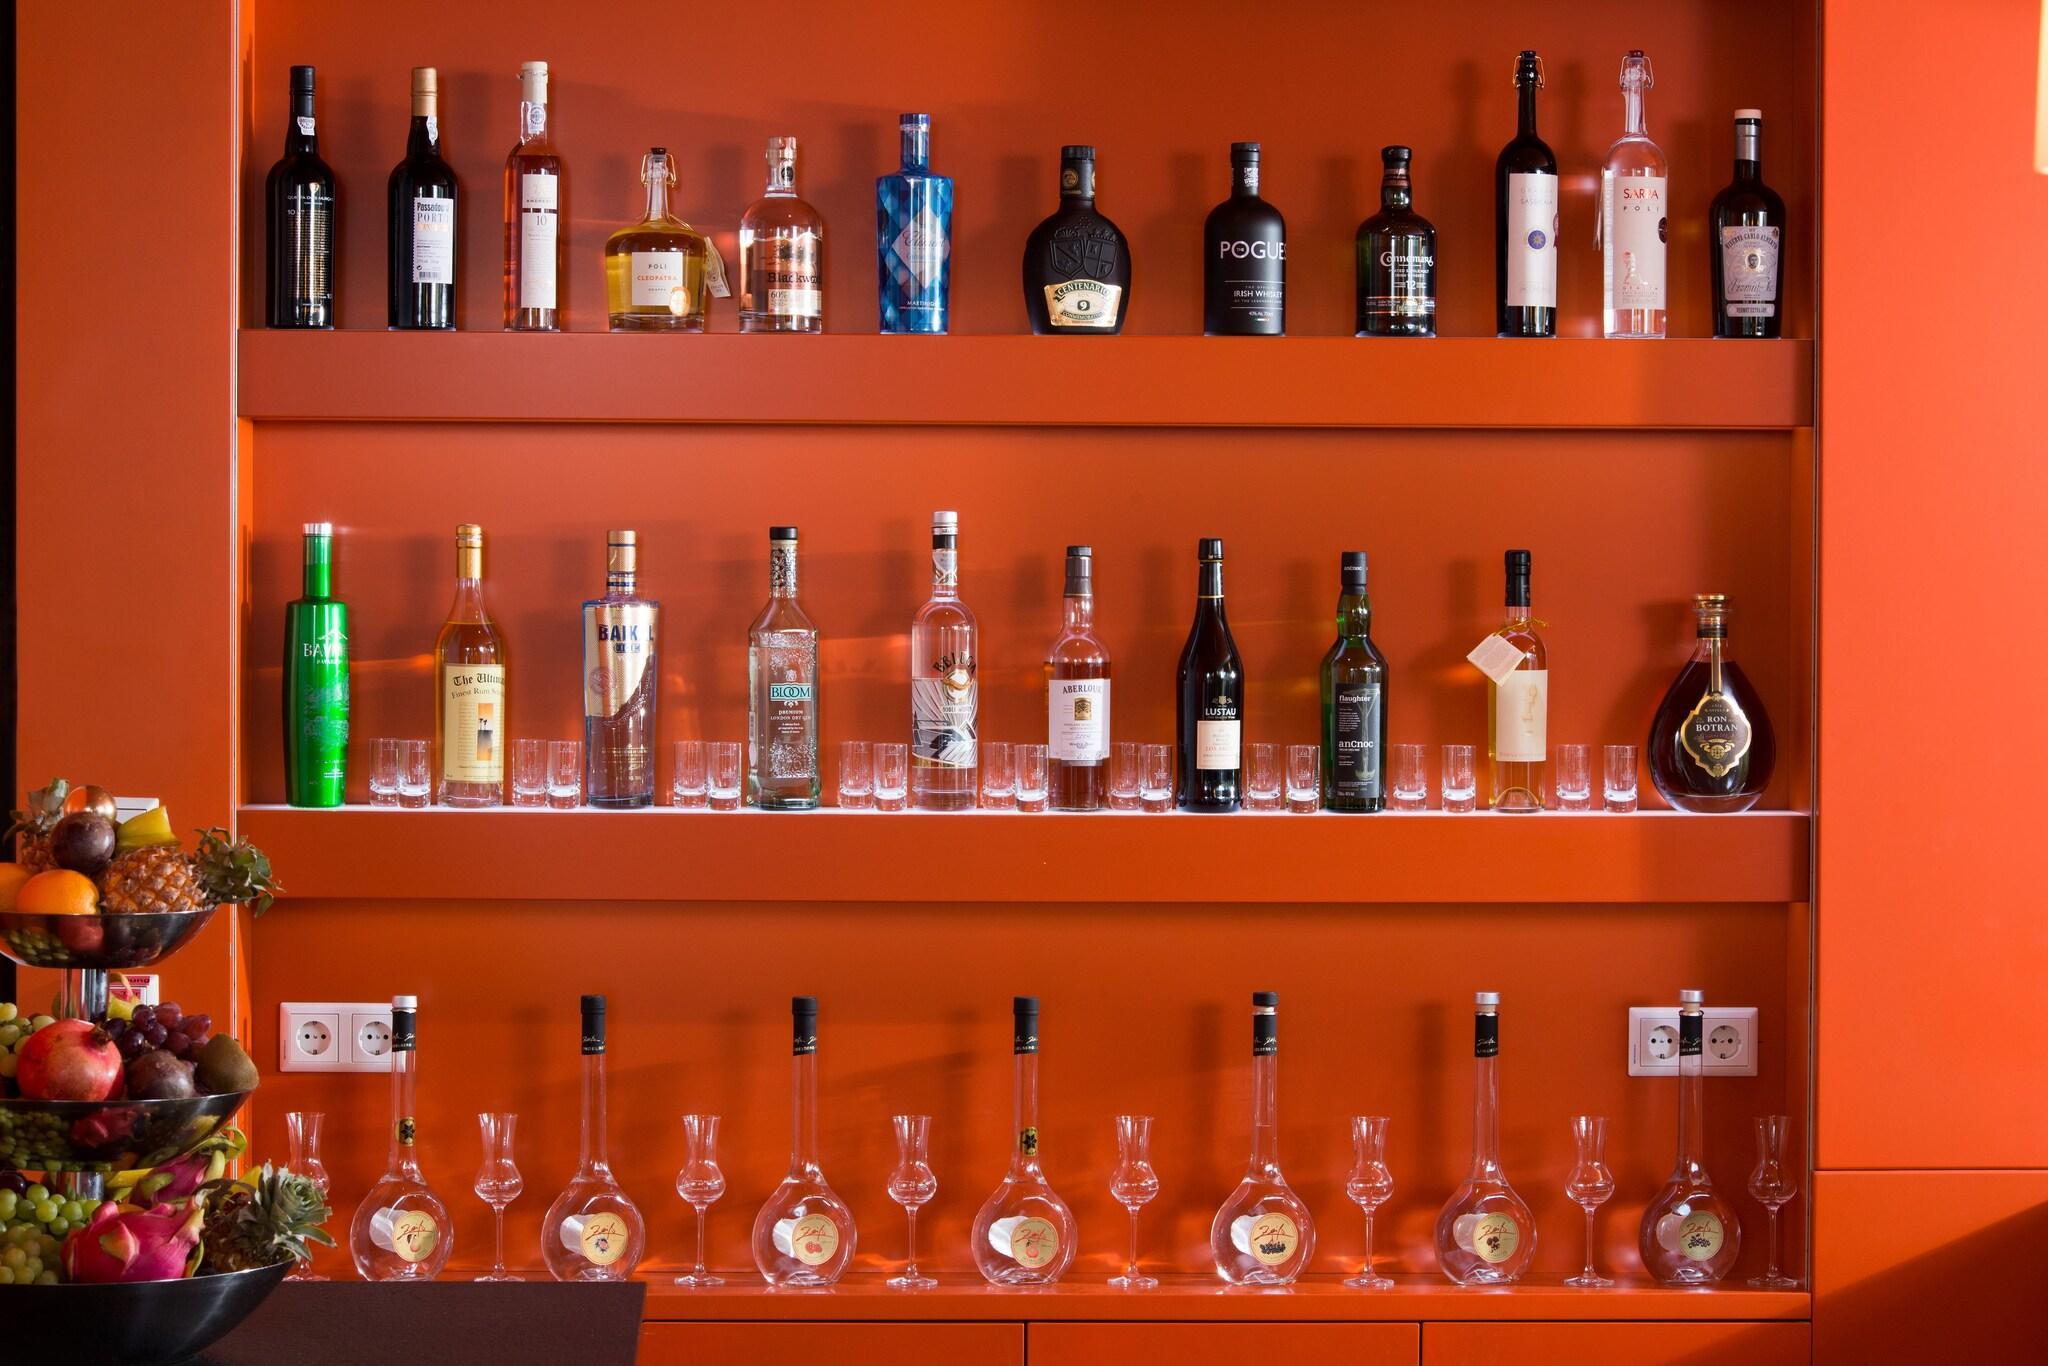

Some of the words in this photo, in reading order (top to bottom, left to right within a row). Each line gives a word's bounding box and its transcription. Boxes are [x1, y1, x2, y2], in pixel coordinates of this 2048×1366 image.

[536, 215, 547, 226] 10
[1057, 281, 1109, 298] CENTENARIO
[1405, 280, 1416, 290] 12
[1079, 301, 1088, 311] 9
[453, 675, 473, 686] The
[772, 686, 810, 698] BLOOM
[1339, 694, 1372, 703] flaughter
[1205, 707, 1237, 716] LUSTAU
[1707, 715, 1727, 723] RON
[1695, 723, 1738, 732] BOTRAN
[1338, 740, 1374, 748] anCnoc
